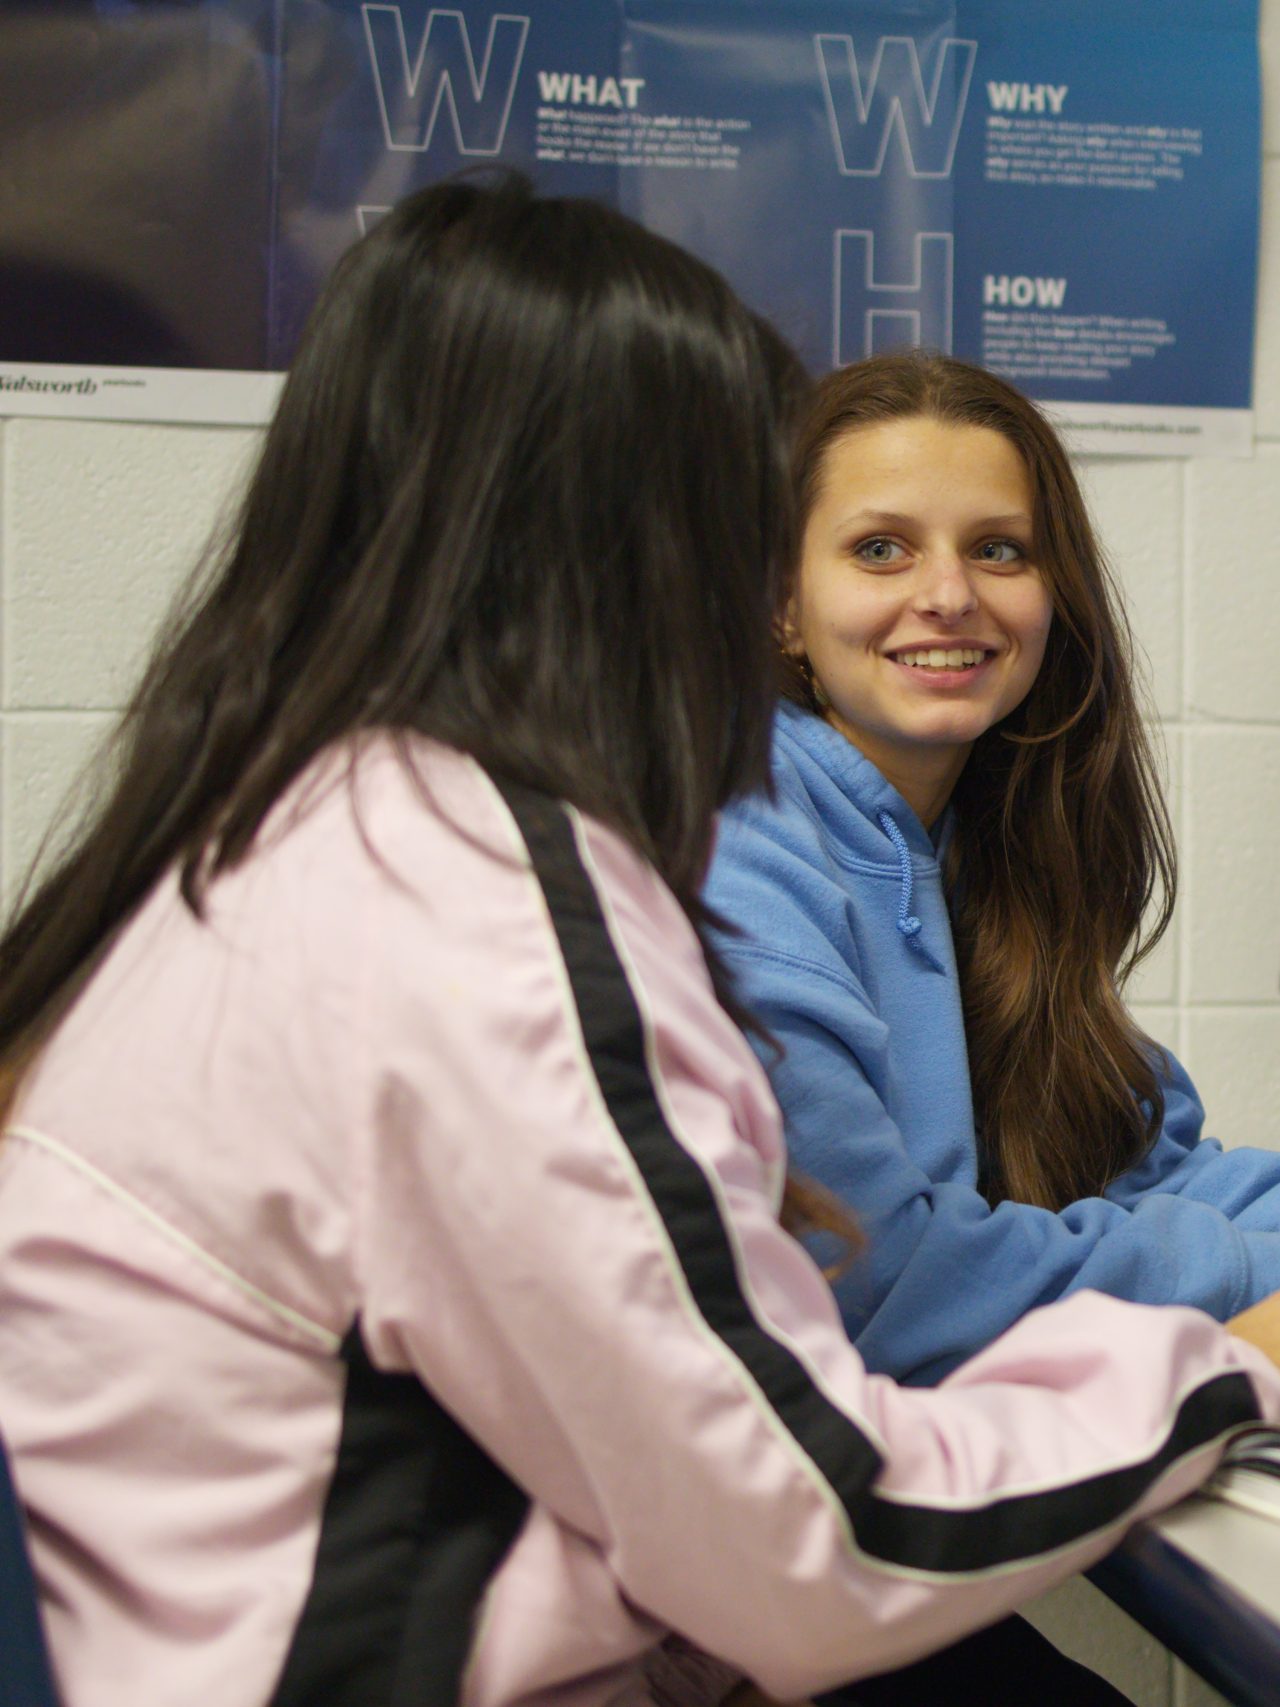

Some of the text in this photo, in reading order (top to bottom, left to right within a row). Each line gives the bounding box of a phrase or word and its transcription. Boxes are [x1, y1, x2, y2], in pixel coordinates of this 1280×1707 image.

[538, 71, 645, 108] WHAT
[987, 81, 1069, 113] WHY
[983, 274, 1067, 307] HOW
